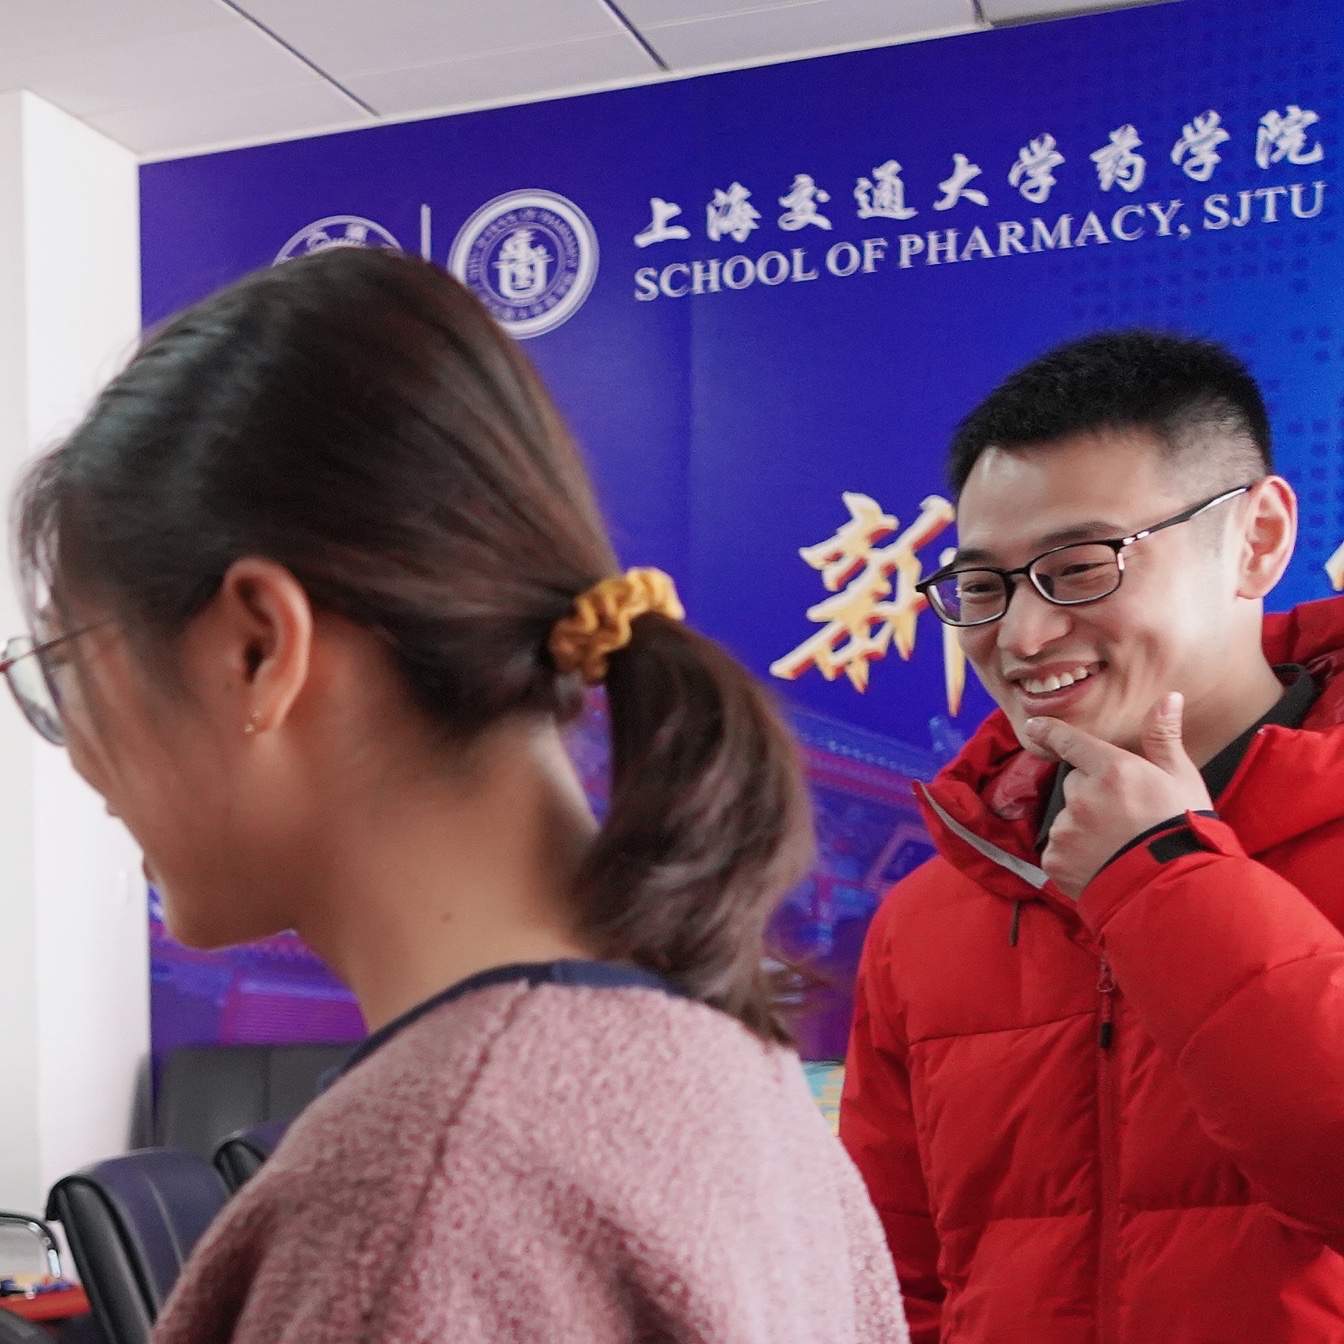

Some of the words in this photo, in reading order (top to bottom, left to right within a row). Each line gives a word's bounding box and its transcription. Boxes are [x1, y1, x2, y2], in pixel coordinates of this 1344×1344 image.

[633, 104, 1324, 248] 上海交通大学药学院
[634, 242, 819, 302] SCHOOL
[826, 237, 889, 279] OF
[898, 198, 1191, 270] PHARMACY,
[1202, 181, 1326, 233] SJTU
